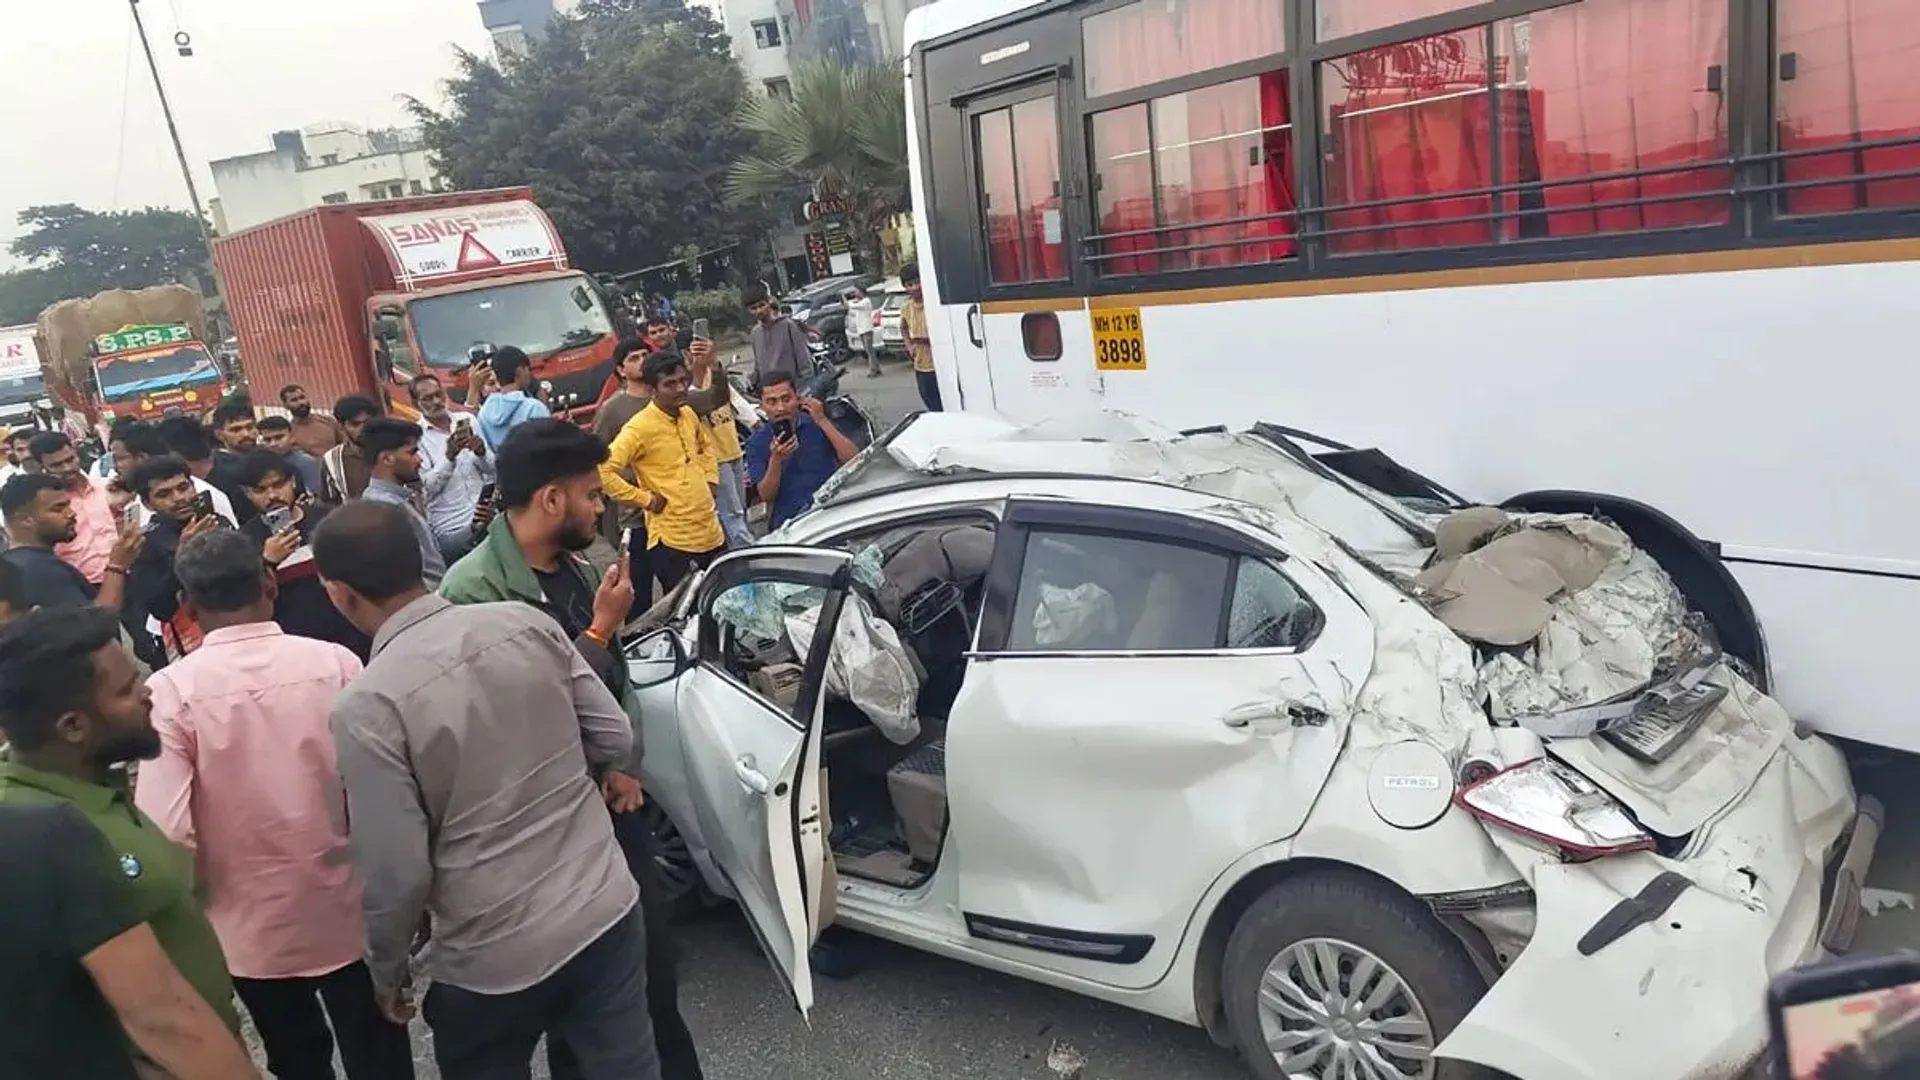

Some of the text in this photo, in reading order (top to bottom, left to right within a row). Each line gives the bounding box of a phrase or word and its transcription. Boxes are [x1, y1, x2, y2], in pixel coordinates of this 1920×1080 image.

[1094, 314, 1138, 332] MH 12 YB
[1098, 338, 1141, 363] 3898
[1388, 779, 1435, 787] PETROL
